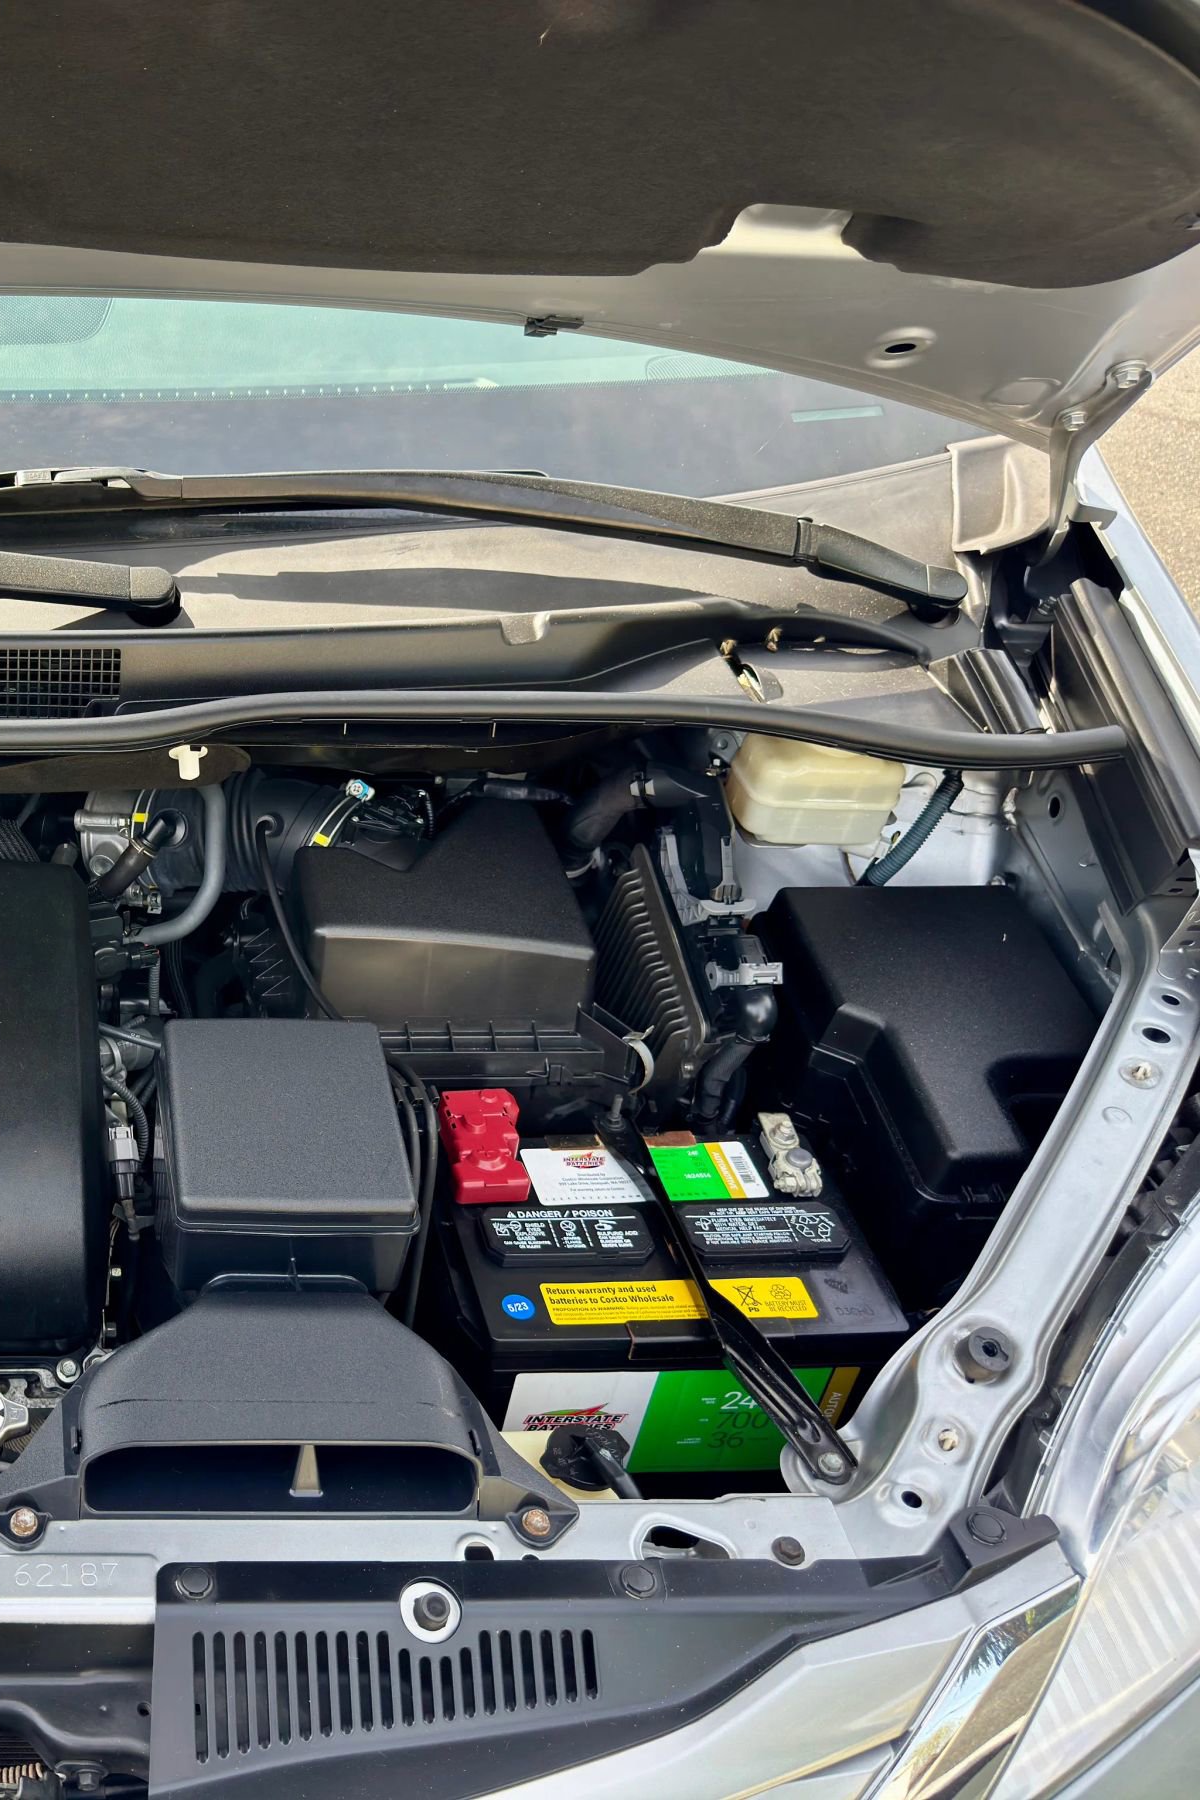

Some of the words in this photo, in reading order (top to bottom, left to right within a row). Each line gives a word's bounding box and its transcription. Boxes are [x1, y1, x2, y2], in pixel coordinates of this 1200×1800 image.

[516, 1210, 560, 1218] DANGER
[564, 1210, 569, 1218] /
[571, 1209, 613, 1218] POISON
[546, 1287, 575, 1295] Return
[577, 1287, 616, 1296] warranty
[618, 1285, 634, 1293] and
[636, 1285, 657, 1293] used
[549, 1296, 588, 1305] batteries
[600, 1295, 628, 1304] Costco
[629, 1294, 675, 1303] Wholesale
[507, 1302, 529, 1313] 5/23
[525, 1414, 623, 1424] INTERSTATE
[716, 1411, 769, 1429] 700
[707, 1431, 744, 1449] 36
[14, 1562, 119, 1587] 62187
